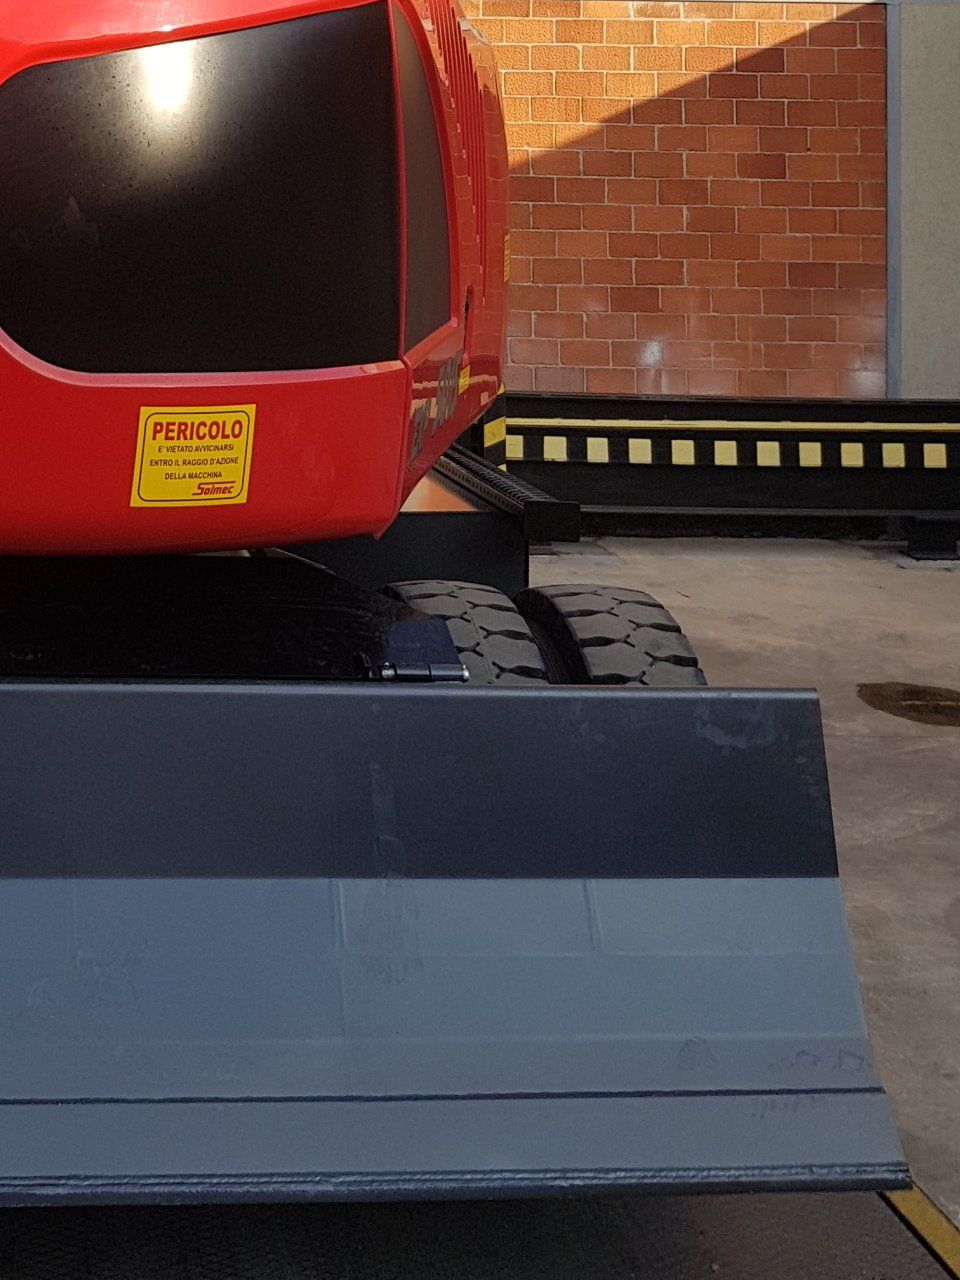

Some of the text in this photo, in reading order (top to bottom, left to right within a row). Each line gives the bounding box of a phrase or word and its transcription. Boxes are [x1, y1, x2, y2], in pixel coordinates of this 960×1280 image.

[152, 419, 243, 441] PERICOLO
[166, 444, 193, 453] VIETATO
[194, 443, 235, 452] AVVICINARSI
[149, 456, 240, 467] ENTRO IL RAGGIO D'AZIONE
[164, 471, 222, 480] DELLA MACCHINA
[192, 480, 237, 496] Solmec
